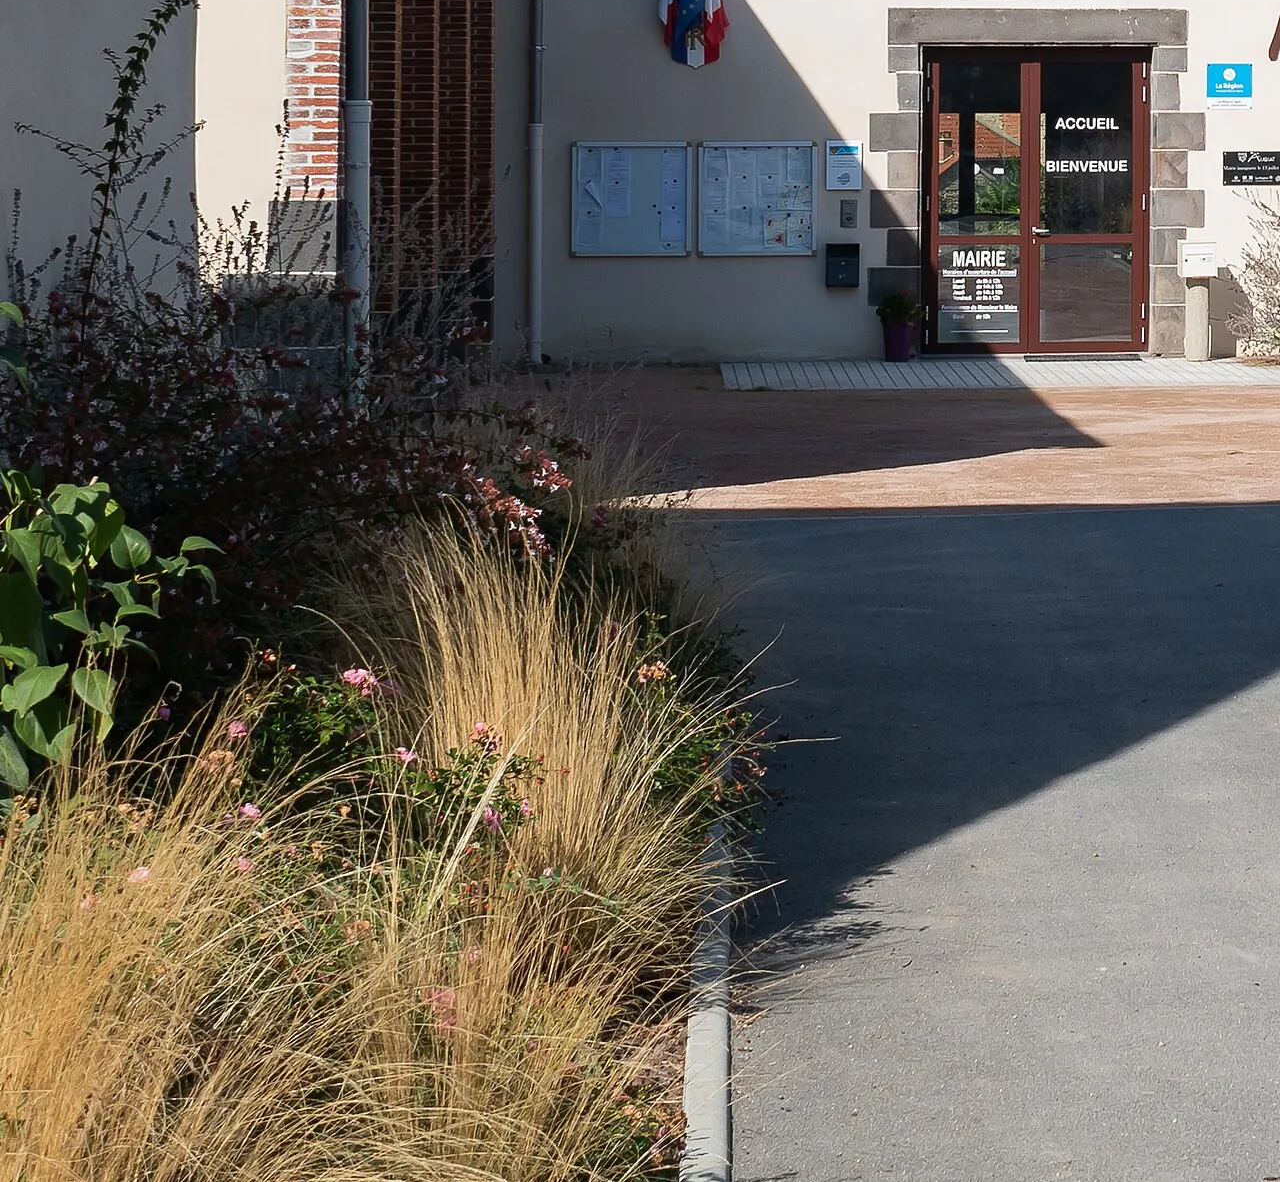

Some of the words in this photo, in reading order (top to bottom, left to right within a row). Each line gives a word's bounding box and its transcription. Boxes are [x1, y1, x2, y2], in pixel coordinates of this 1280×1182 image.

[1223, 82, 1244, 90] Région
[1055, 117, 1119, 130] ACCUEIL
[1046, 160, 1128, 172] BIENVENUE
[952, 250, 1007, 267] MAIRIE
